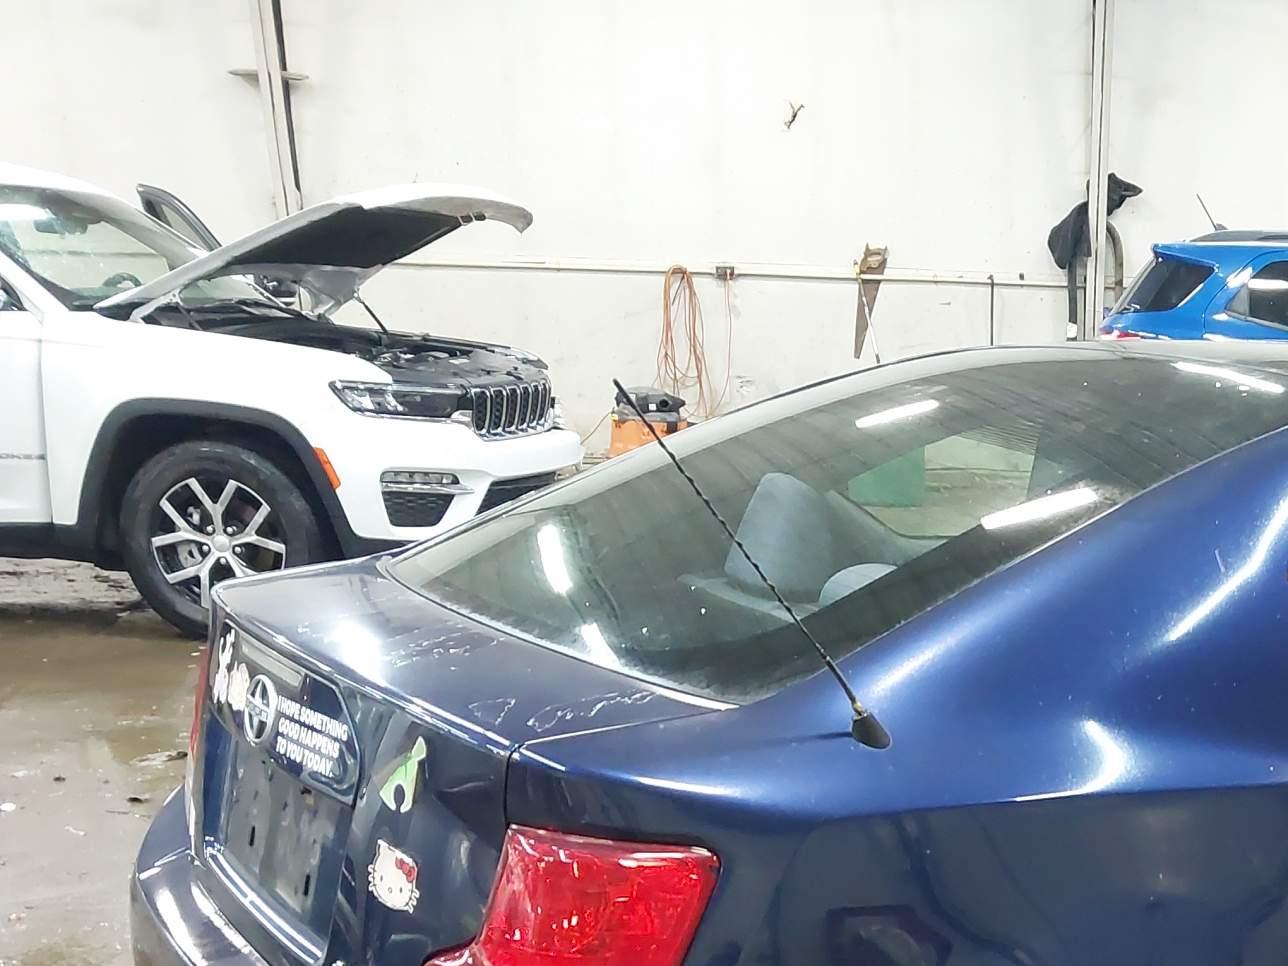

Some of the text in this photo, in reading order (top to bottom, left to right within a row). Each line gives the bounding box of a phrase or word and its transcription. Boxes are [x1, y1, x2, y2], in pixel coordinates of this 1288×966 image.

[278, 717, 340, 759] GOOD HAPPENS
[281, 696, 301, 718] HOPE
[300, 706, 348, 742] SOMETHING
[276, 736, 335, 777] TO YOU TODAY.
